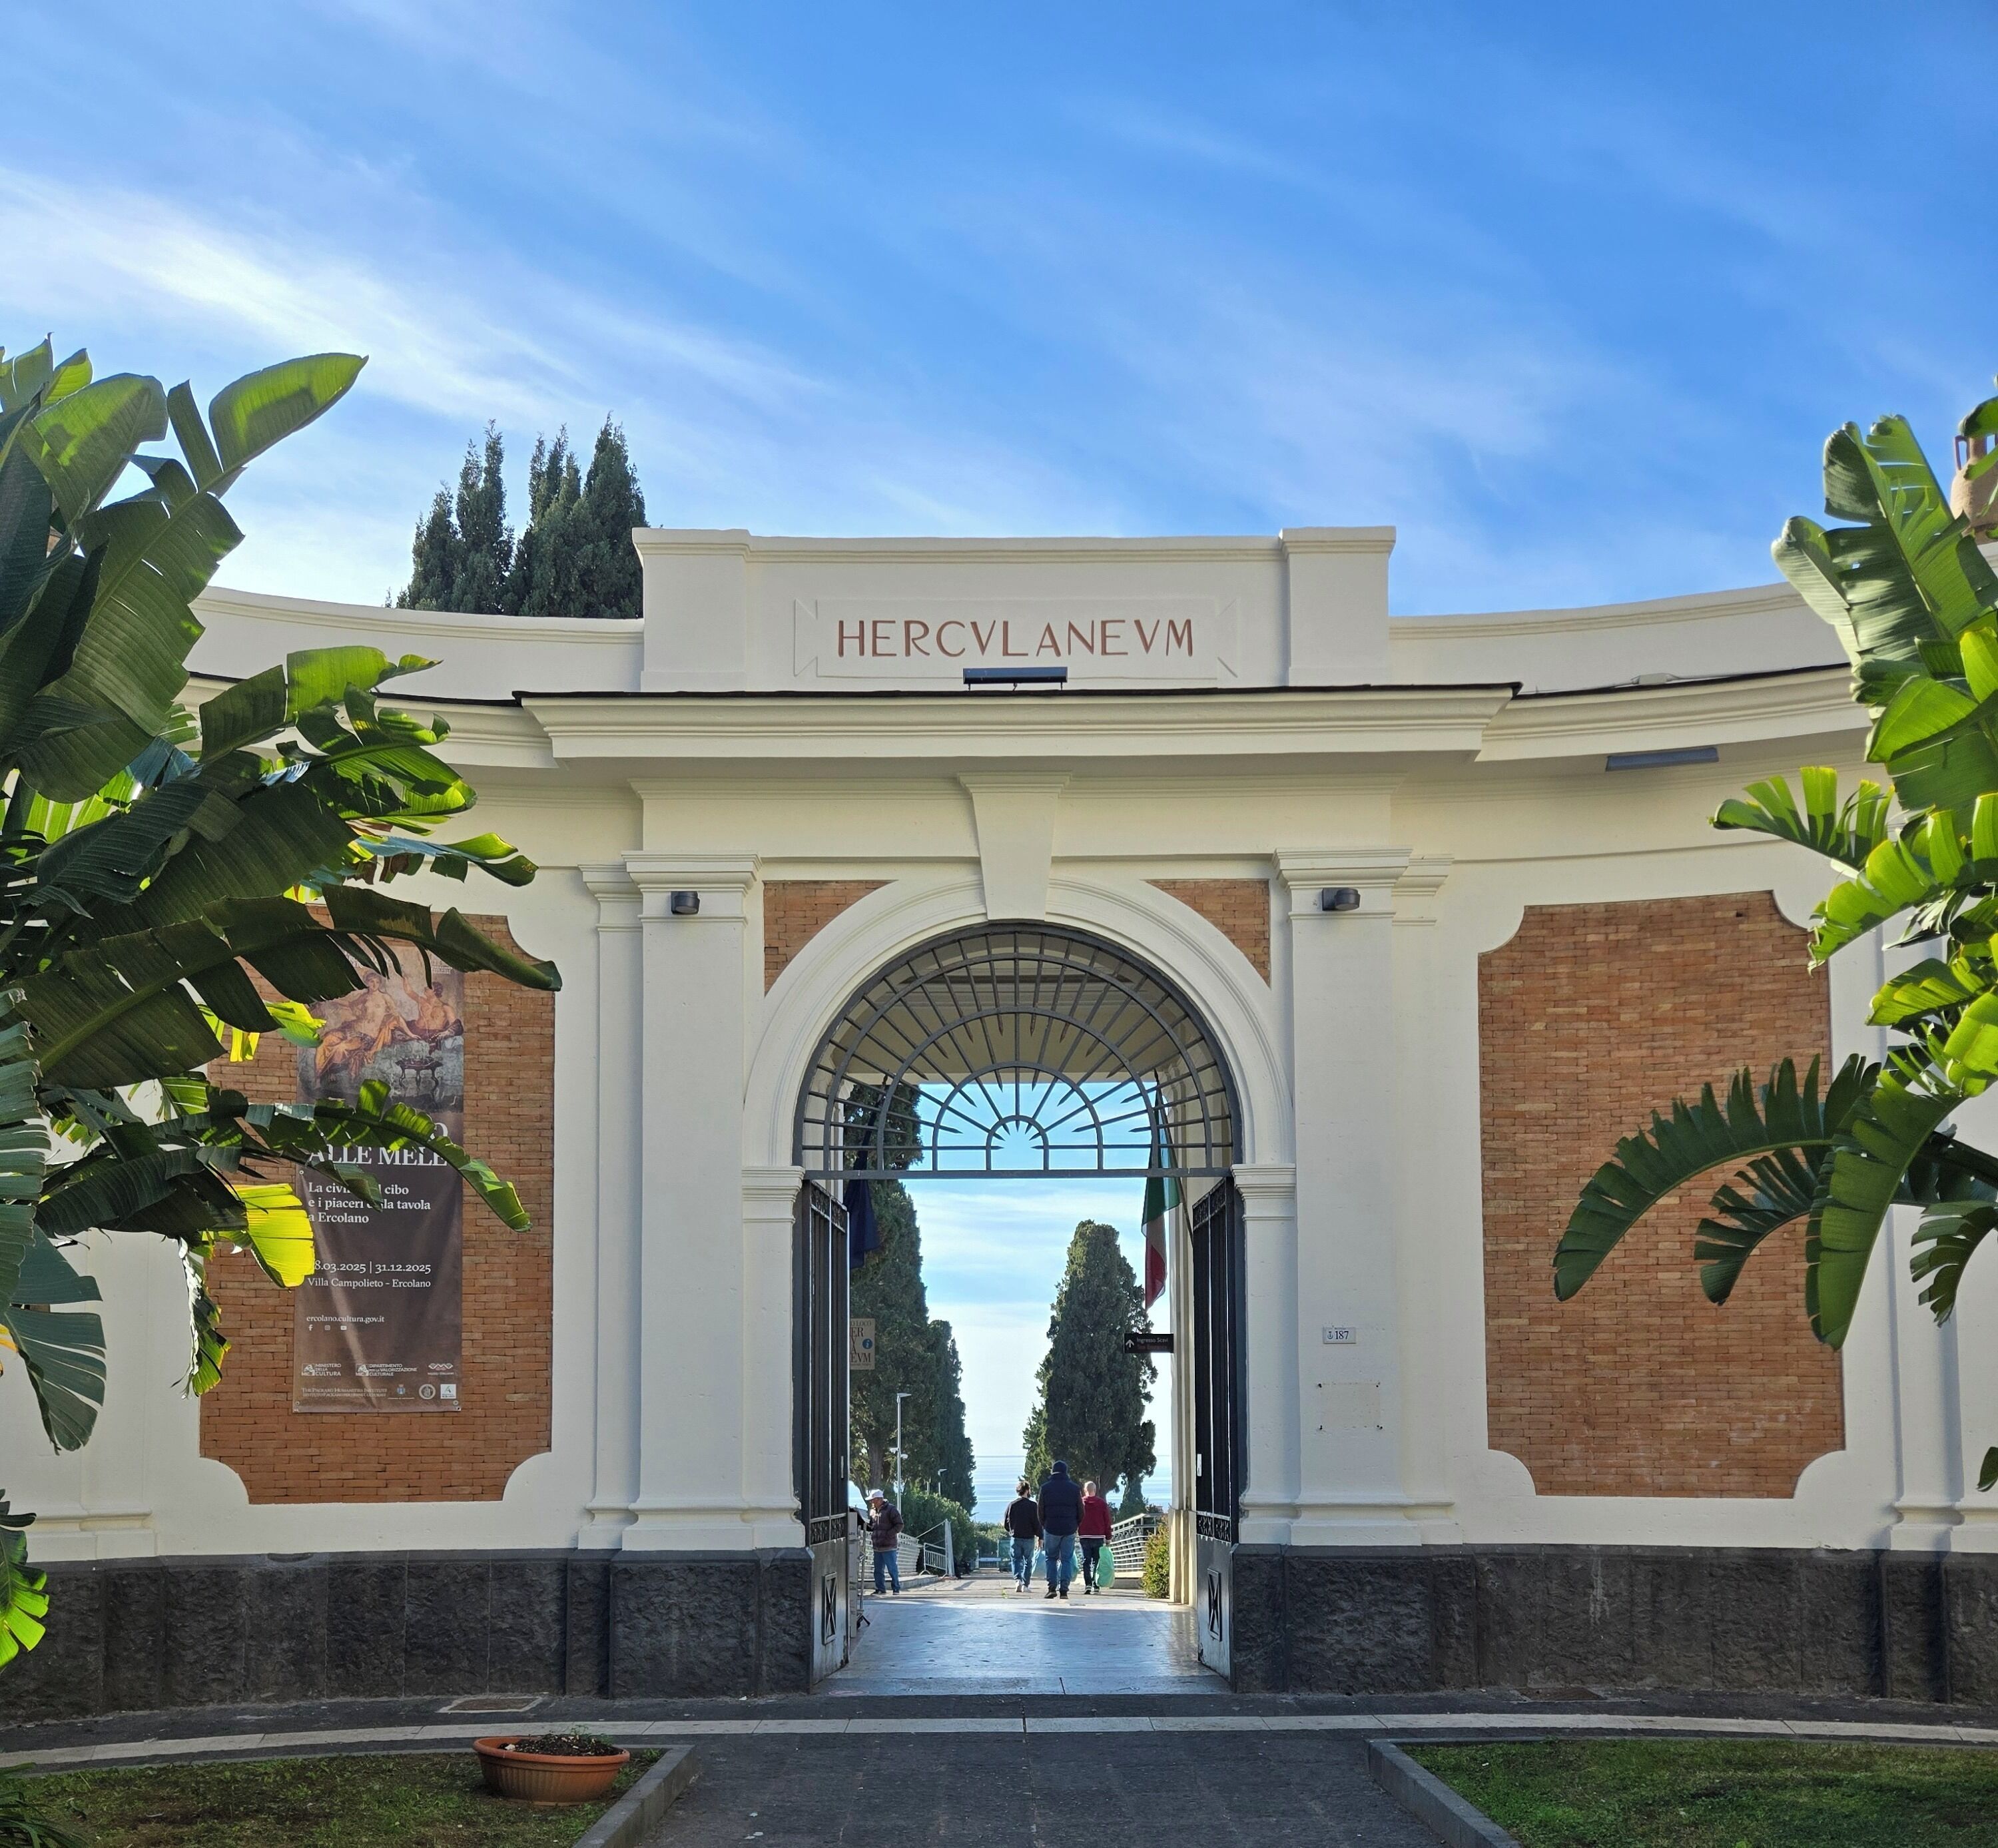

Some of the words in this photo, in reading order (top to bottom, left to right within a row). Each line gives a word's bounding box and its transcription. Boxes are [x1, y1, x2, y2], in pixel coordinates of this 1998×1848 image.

[838, 619, 1193, 657] HERCVLANEVM
[308, 1182, 323, 1193] La
[384, 1184, 410, 1195] cibo
[318, 1197, 322, 1207] i
[396, 1199, 431, 1210] tavola
[318, 1212, 370, 1223] Ercolano
[315, 1260, 366, 1273] 8.03.2025
[375, 1264, 432, 1274] 31.12.2025
[308, 1277, 329, 1287] Villa
[331, 1278, 384, 1289] Campolieto
[392, 1279, 432, 1287] Ercolano
[306, 1315, 385, 1323] ercolano.cultura.gov.it
[1335, 1331, 1349, 1339] 187
